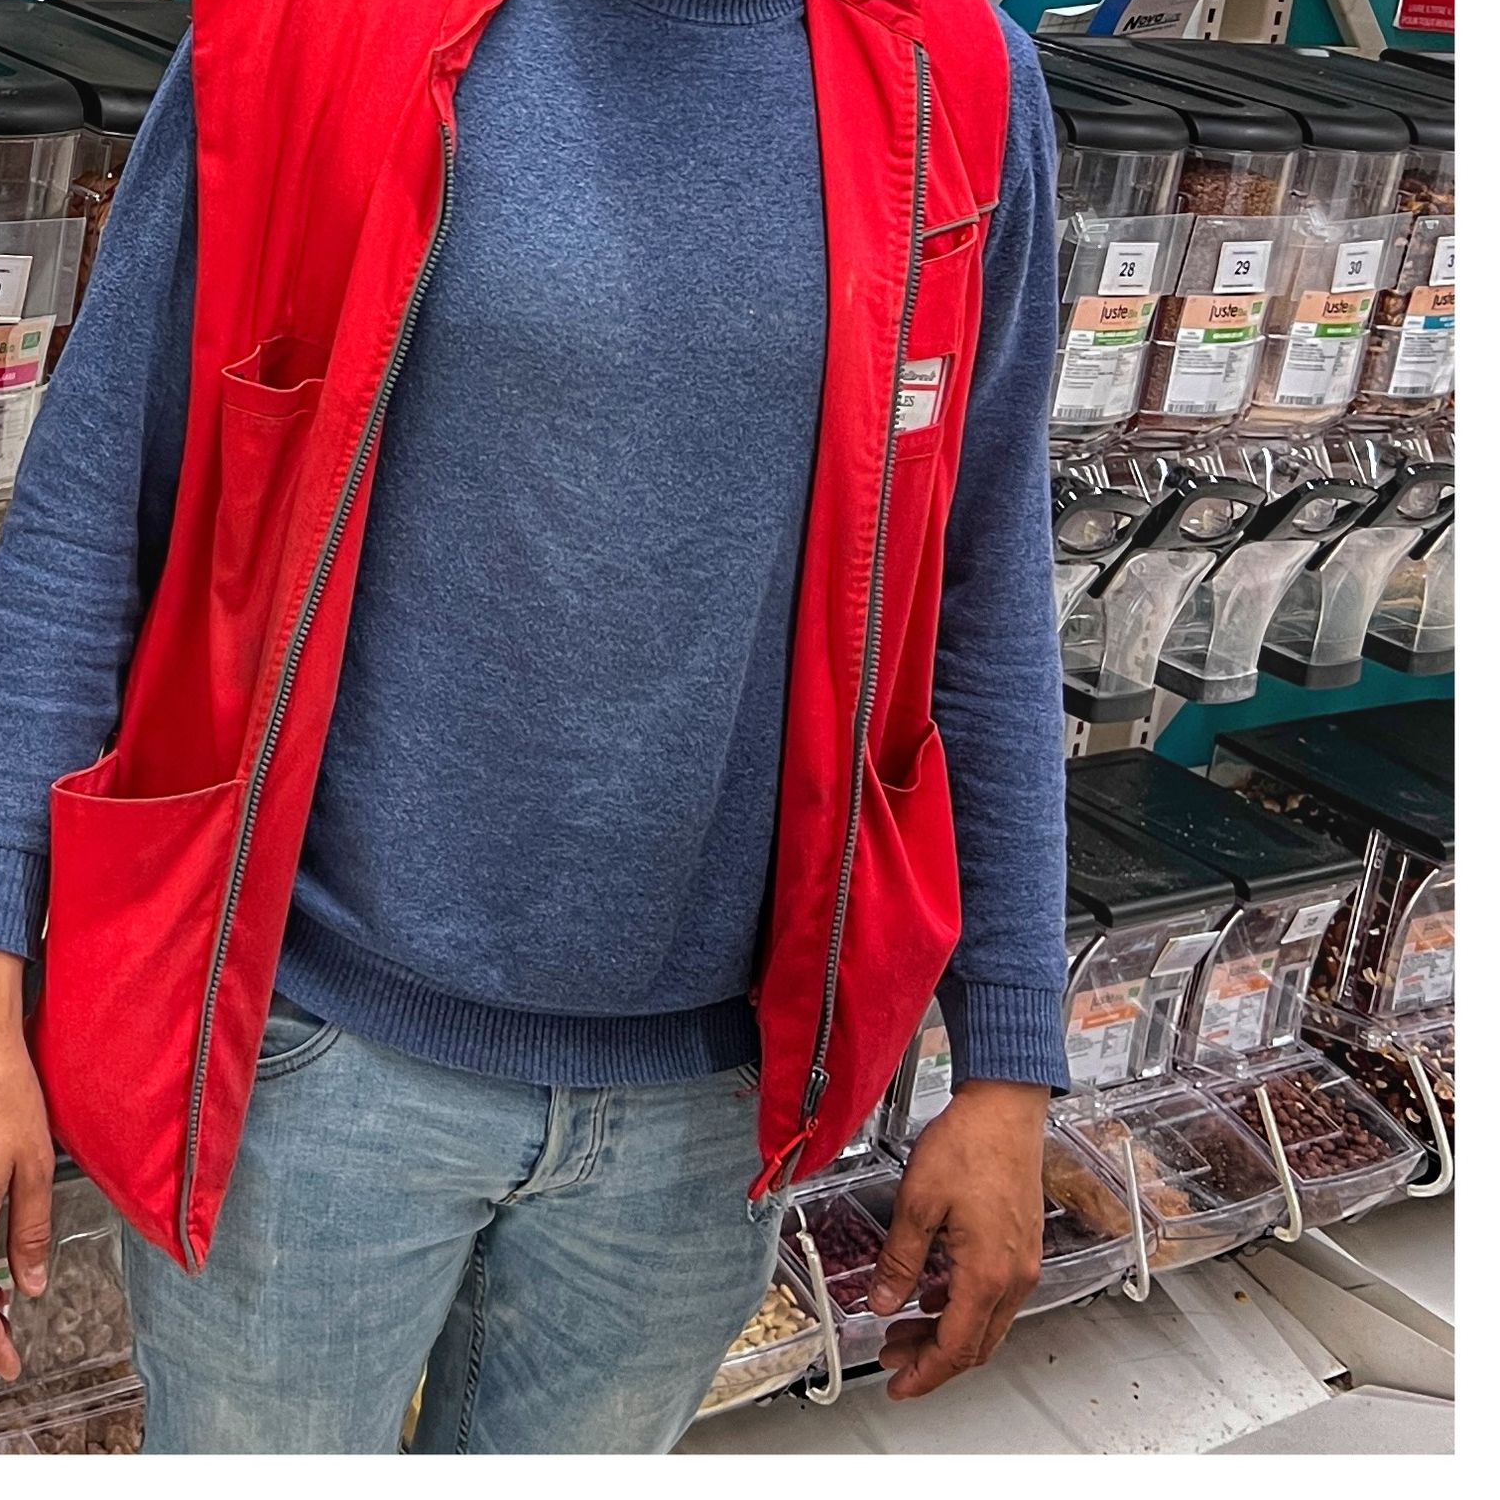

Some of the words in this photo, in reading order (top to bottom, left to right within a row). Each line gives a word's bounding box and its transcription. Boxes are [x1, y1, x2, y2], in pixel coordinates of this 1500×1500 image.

[1119, 262, 1136, 277] 28
[1234, 260, 1251, 275] 29
[1347, 260, 1362, 275] 30
[1100, 301, 1128, 323] juste
[1209, 299, 1238, 322] juste
[1322, 296, 1349, 317] juste
